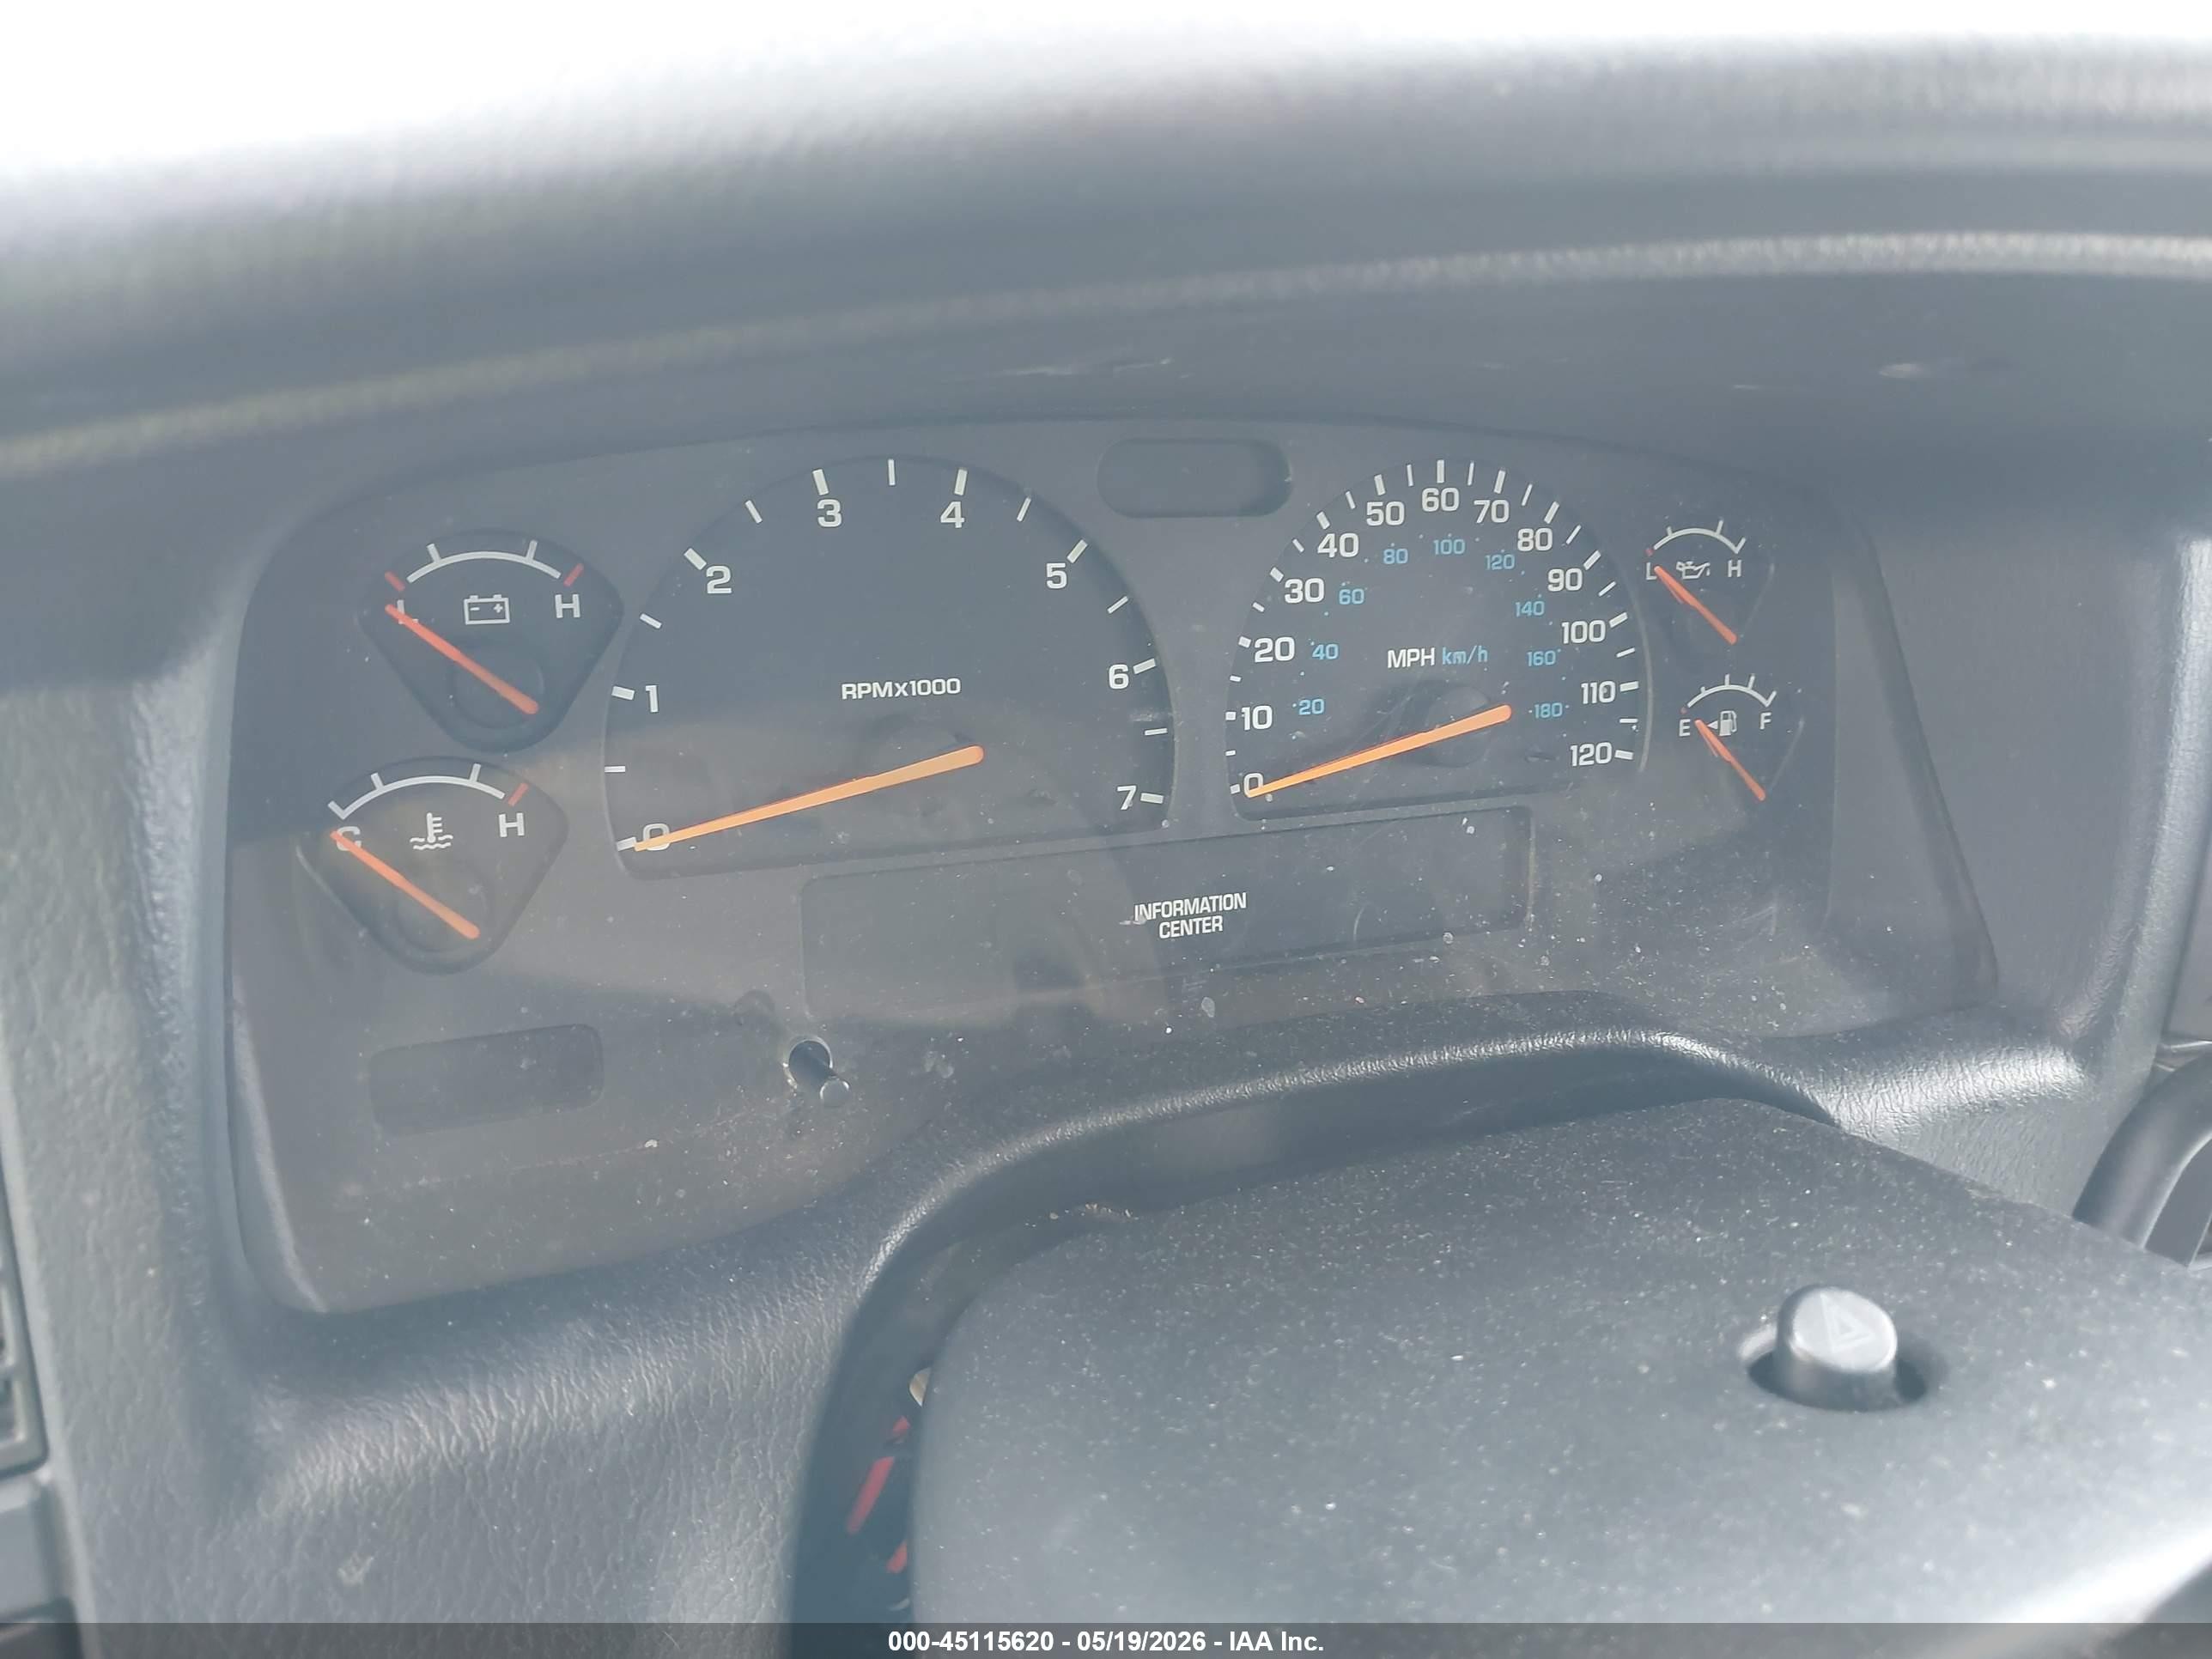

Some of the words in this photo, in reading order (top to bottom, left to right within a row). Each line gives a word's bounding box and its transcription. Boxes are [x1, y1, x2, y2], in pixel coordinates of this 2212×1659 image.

[1421, 488, 1459, 512] 60
[1474, 500, 1510, 524] 70
[817, 500, 842, 527] 3
[940, 501, 965, 529] 4
[1366, 501, 1405, 526] 50
[1317, 532, 1359, 557] 40
[1433, 539, 1466, 556] 100
[1516, 528, 1553, 551] 80
[1382, 548, 1408, 565] 80
[1485, 554, 1515, 570] 120
[707, 565, 732, 594] 2
[1046, 563, 1067, 590] 5
[1547, 568, 1583, 592] 90
[1646, 562, 1656, 580] L
[1728, 560, 1741, 578] H
[1285, 578, 1325, 603] 30
[1338, 588, 1365, 605] 60
[556, 594, 580, 618] H
[1515, 600, 1545, 617] 140
[1561, 619, 1606, 644] 100
[1254, 636, 1295, 663] 20
[1311, 644, 1339, 659] 40
[1387, 647, 1436, 668] MPH
[1442, 646, 1488, 666] km/h
[1527, 650, 1556, 666] 160
[842, 678, 961, 700] RPMx1000
[1109, 664, 1129, 690] 6
[645, 685, 659, 713] 1
[1580, 681, 1616, 705] 110
[1241, 704, 1273, 731] 10
[1298, 699, 1324, 715] 20
[1534, 702, 1563, 719] 180
[1679, 719, 1691, 737] E
[1760, 712, 1771, 730] F
[1570, 741, 1612, 767] 120
[1116, 785, 1138, 810] 7
[499, 812, 525, 837] H
[642, 823, 671, 850] 0
[1133, 891, 1247, 922] INFORMATION
[1158, 915, 1224, 939] CENTER
